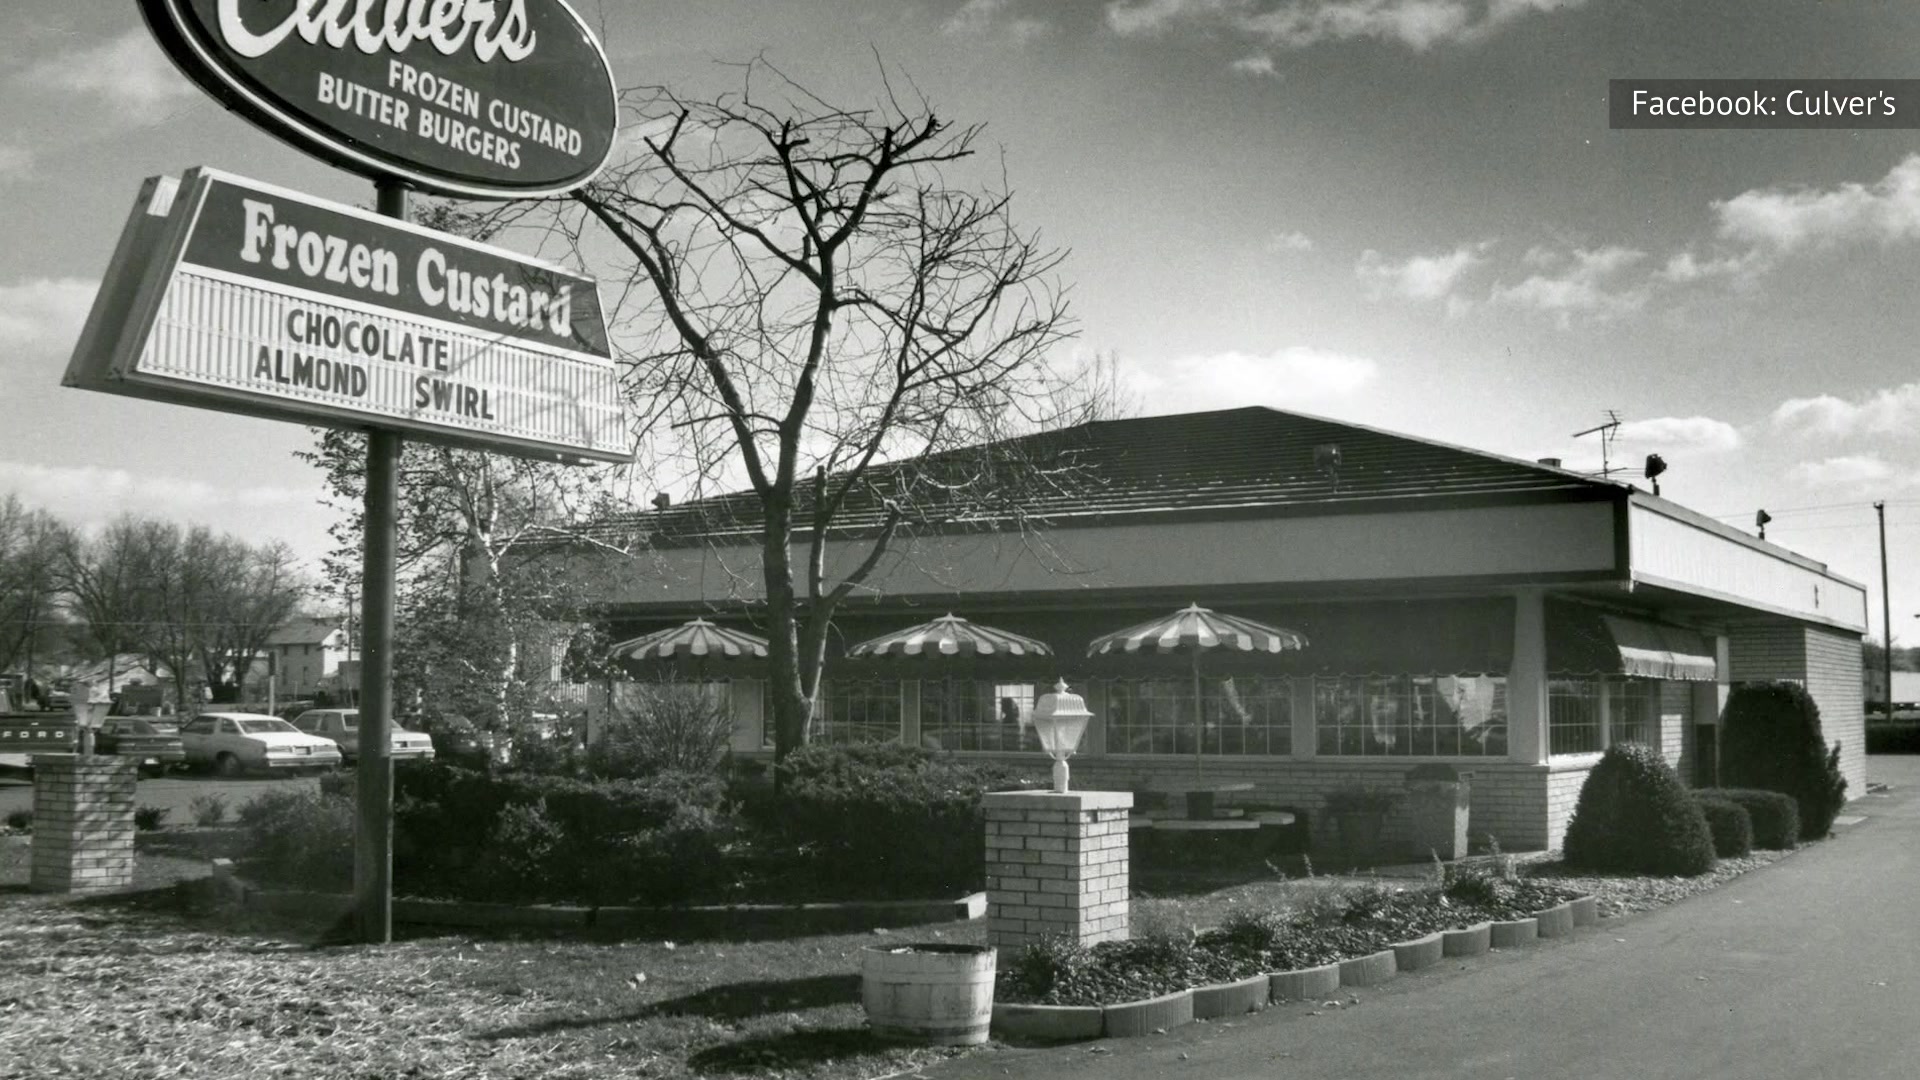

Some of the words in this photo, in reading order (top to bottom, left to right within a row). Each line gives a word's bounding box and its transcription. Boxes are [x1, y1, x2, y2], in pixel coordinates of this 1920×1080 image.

[216, 0, 536, 62] Culvers
[317, 72, 409, 130] BUTTER
[418, 113, 521, 169] BURGERS
[388, 59, 479, 118] FROZEN
[488, 100, 582, 157] CUSTARD
[240, 198, 400, 296] Frozen
[416, 247, 572, 337] Custard
[287, 308, 449, 373] CHOCOLATE
[254, 346, 368, 398] ALMOND
[414, 376, 494, 422] SWIRL
[2, 730, 65, 738] FORD
